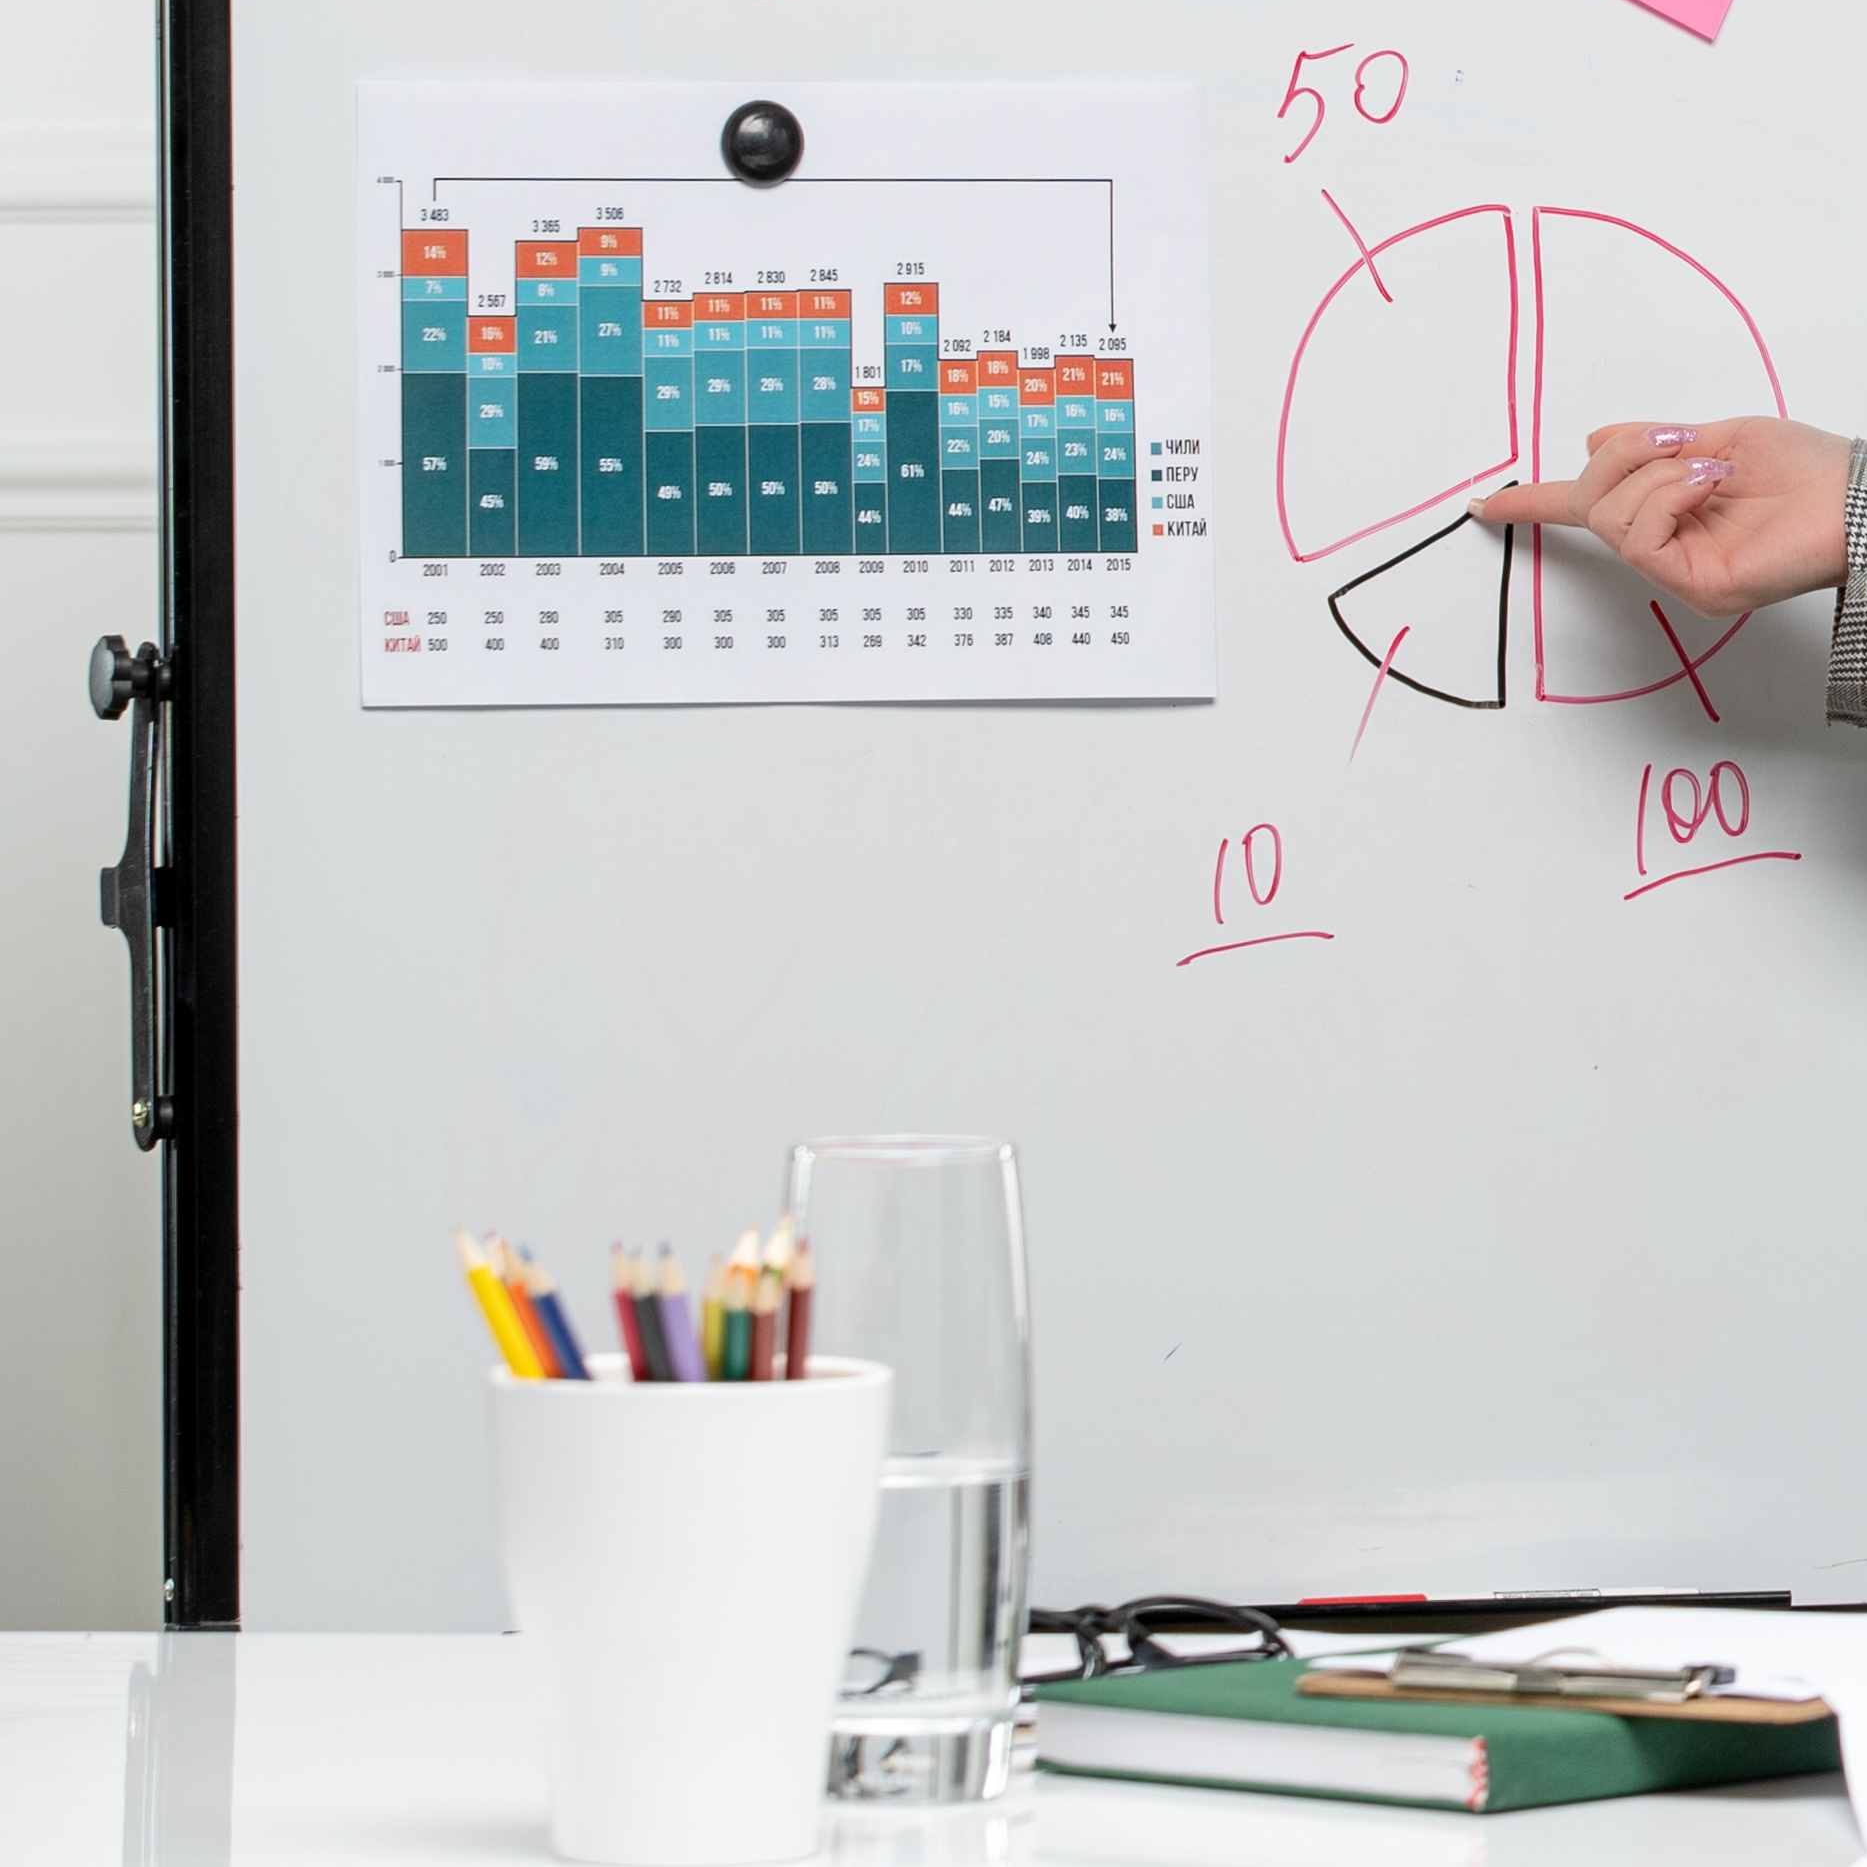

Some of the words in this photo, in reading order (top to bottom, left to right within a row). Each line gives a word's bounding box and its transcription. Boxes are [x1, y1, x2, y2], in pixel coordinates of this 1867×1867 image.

[1277, 42, 1410, 163] 50
[760, 297, 782, 310] 11%
[813, 296, 835, 310] 11%
[900, 291, 922, 305] 12%
[708, 299, 730, 312] 11%
[657, 307, 679, 320] 11%
[708, 328, 730, 342] 11%
[761, 325, 783, 339] 11%
[814, 325, 836, 339] 11%
[900, 321, 922, 335] 10%
[658, 334, 679, 347] 11%
[901, 359, 922, 373] 17%
[1062, 368, 1085, 382] 21%
[1101, 372, 1125, 386] 21%
[1024, 379, 1048, 392] 20%
[987, 394, 1009, 408] 15%
[857, 418, 880, 432] 17%
[1027, 414, 1048, 428] 17%
[987, 430, 1010, 444] 20%
[947, 439, 970, 454] 22%
[1064, 442, 1087, 456] 23%
[1165, 439, 1200, 455] ЧИЛИ
[856, 453, 880, 467] 24%
[1026, 451, 1049, 465] 24%
[1104, 447, 1126, 461] 24%
[422, 457, 447, 471] 57%
[900, 464, 924, 478] 61%
[1166, 466, 1199, 482] ПЕРУ
[708, 482, 732, 497] 50%
[761, 481, 785, 495] 50%
[814, 481, 838, 495] 50%
[988, 498, 1012, 512] 47%
[1166, 494, 1195, 509] США
[857, 510, 882, 524] 44%
[948, 503, 972, 517] 44%
[1027, 509, 1051, 523] 39%
[1066, 505, 1089, 520] 40%
[1104, 507, 1128, 522] 38%
[1167, 520, 1207, 536] КИТАЙ
[423, 564, 448, 576] 2001
[480, 564, 505, 576] 2002
[536, 564, 561, 576] 2003
[599, 563, 625, 576] 2004
[657, 562, 683, 575] 2005
[762, 562, 787, 575] 2007
[859, 561, 884, 574] 2009
[903, 560, 928, 573] 2010
[950, 560, 975, 573] 2011
[989, 559, 1015, 572] 2012
[1029, 559, 1054, 572] 2013
[1067, 558, 1092, 571] 2014
[1106, 558, 1131, 571] 2015
[953, 607, 973, 619] 330
[993, 606, 1013, 619] 335
[1032, 606, 1052, 619] 340
[1071, 606, 1090, 618] 345
[1110, 605, 1129, 618] 345
[605, 637, 625, 650] 310
[907, 634, 927, 647] 342
[1071, 632, 1091, 645] 440
[1110, 632, 1130, 645] 450
[1636, 760, 1751, 875] 100
[1213, 822, 1282, 925] 10
